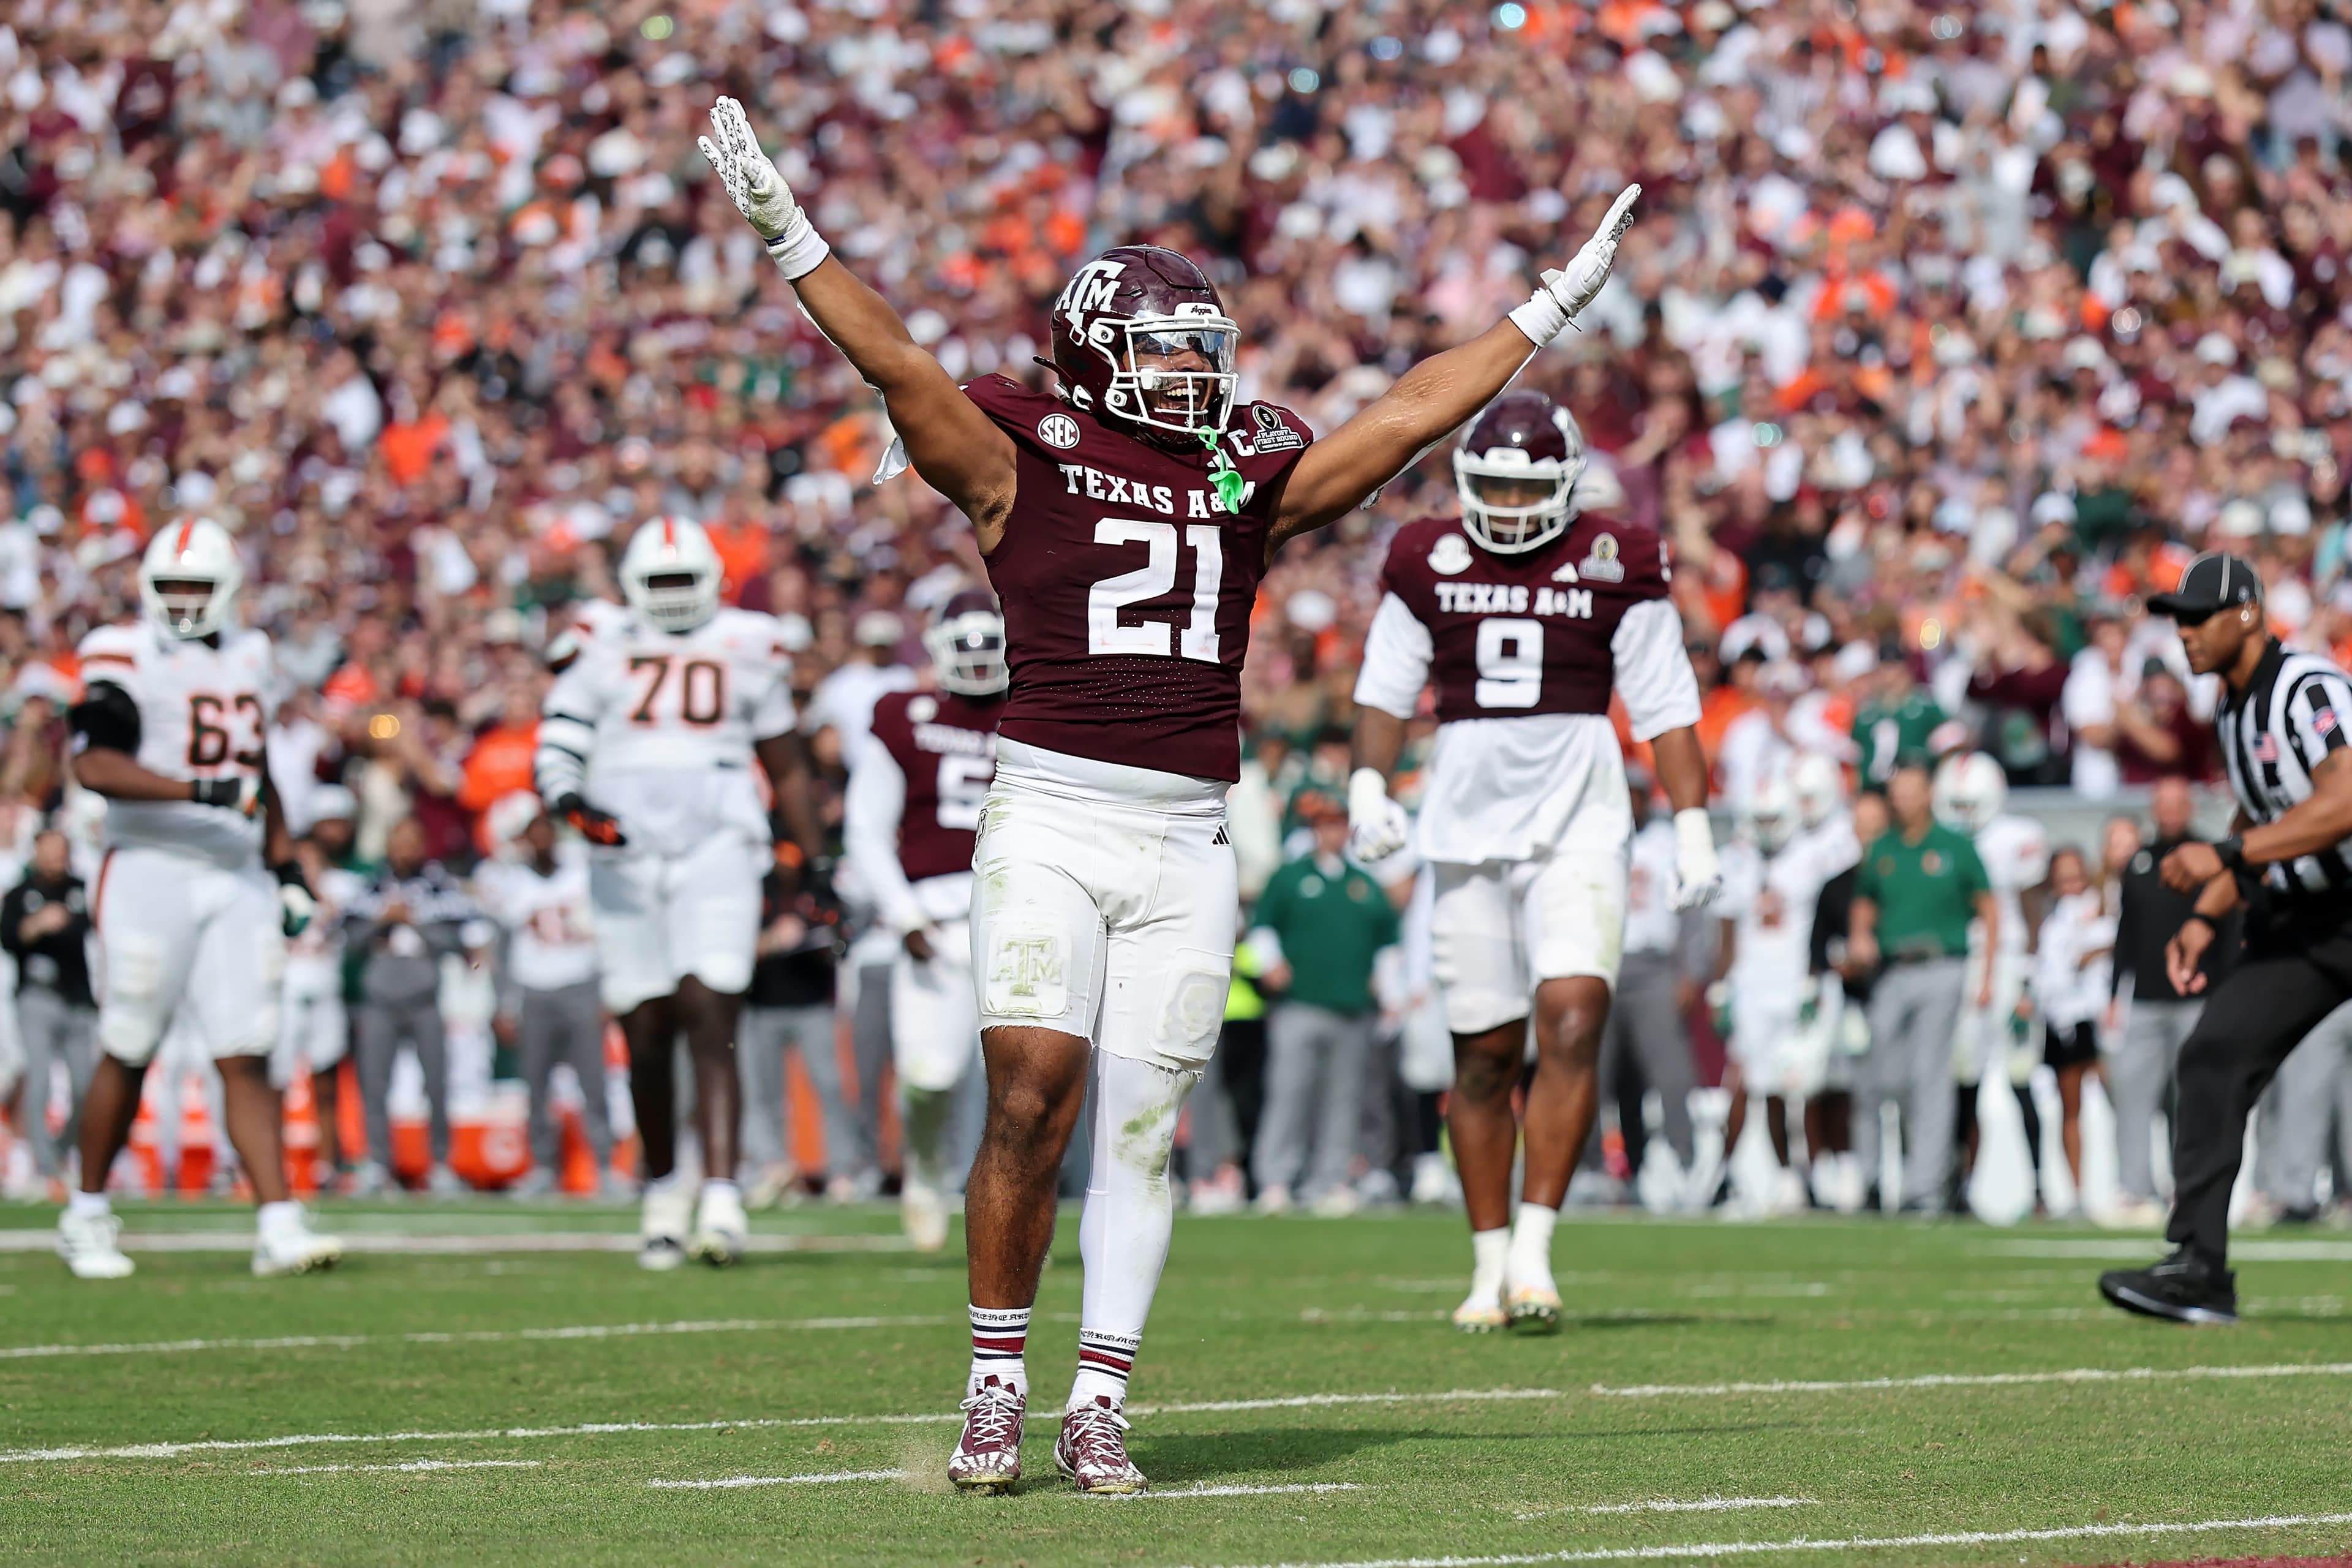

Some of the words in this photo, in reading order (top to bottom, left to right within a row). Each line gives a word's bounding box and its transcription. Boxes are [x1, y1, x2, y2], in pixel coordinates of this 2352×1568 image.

[1040, 415, 1078, 447] SEC
[1227, 429, 1256, 457] C
[1261, 430, 1288, 439] PLAYOFF
[1058, 464, 1174, 514] TEXAS
[1088, 517, 1224, 664] 21
[1434, 581, 1529, 613] TEXAS
[628, 655, 722, 725] 70
[1475, 616, 1545, 709] 9
[189, 693, 265, 767] 63
[937, 755, 995, 831] 5
